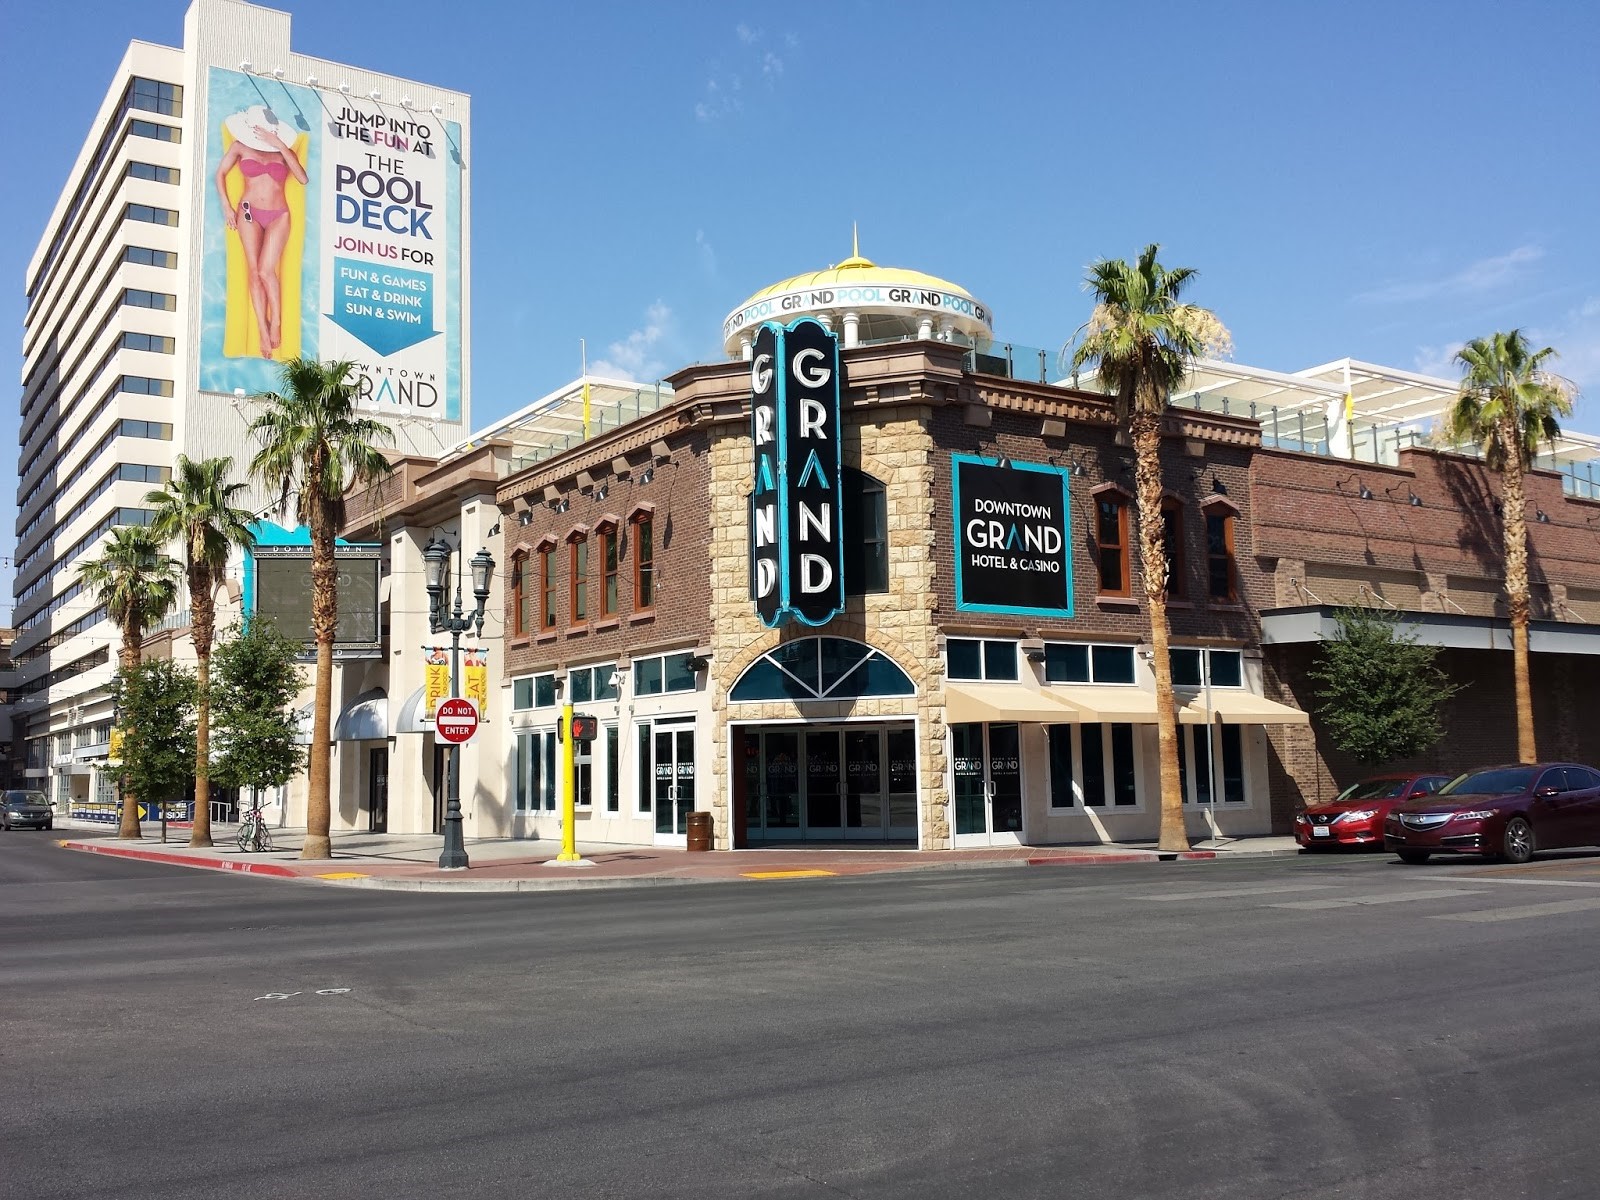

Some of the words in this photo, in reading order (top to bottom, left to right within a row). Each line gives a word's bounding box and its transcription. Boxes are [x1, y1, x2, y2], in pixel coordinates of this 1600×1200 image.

[337, 107, 386, 128] JUMP
[390, 118, 431, 139] INTO
[335, 121, 369, 142] THE
[374, 130, 409, 151] FUN
[412, 141, 433, 155] AT
[365, 153, 404, 175] THE
[336, 164, 433, 210] POOL
[336, 193, 433, 240] DECK
[334, 236, 373, 255] JOIN
[377, 243, 398, 259] US
[401, 247, 434, 266] FOR
[341, 267, 367, 281] FUN
[370, 272, 379, 284] &
[382, 274, 427, 291] GAMES
[345, 285, 369, 298] EAT
[371, 289, 381, 301] &
[383, 291, 422, 308] DRINK
[745, 301, 775, 323] POOL
[781, 290, 834, 310] GRAND
[837, 288, 885, 303] POOL
[888, 289, 941, 306] GRAND
[943, 294, 974, 316] POOL
[346, 303, 373, 316] SUN
[375, 307, 384, 319] &
[387, 309, 421, 324] SWIM
[332, 359, 436, 381] DWNTOWN
[751, 353, 776, 599] GRAND
[792, 348, 833, 594] GRAND
[975, 498, 1051, 520] DOWNTOWN
[966, 518, 1062, 554] GRAND
[971, 554, 1008, 569] HOTEL
[1010, 557, 1018, 570] &
[1019, 559, 1060, 573] CASINO
[457, 707, 472, 715] NOT
[809, 765, 838, 773] GRND
[849, 763, 878, 772] GRND
[158, 811, 187, 819] ISIDE
